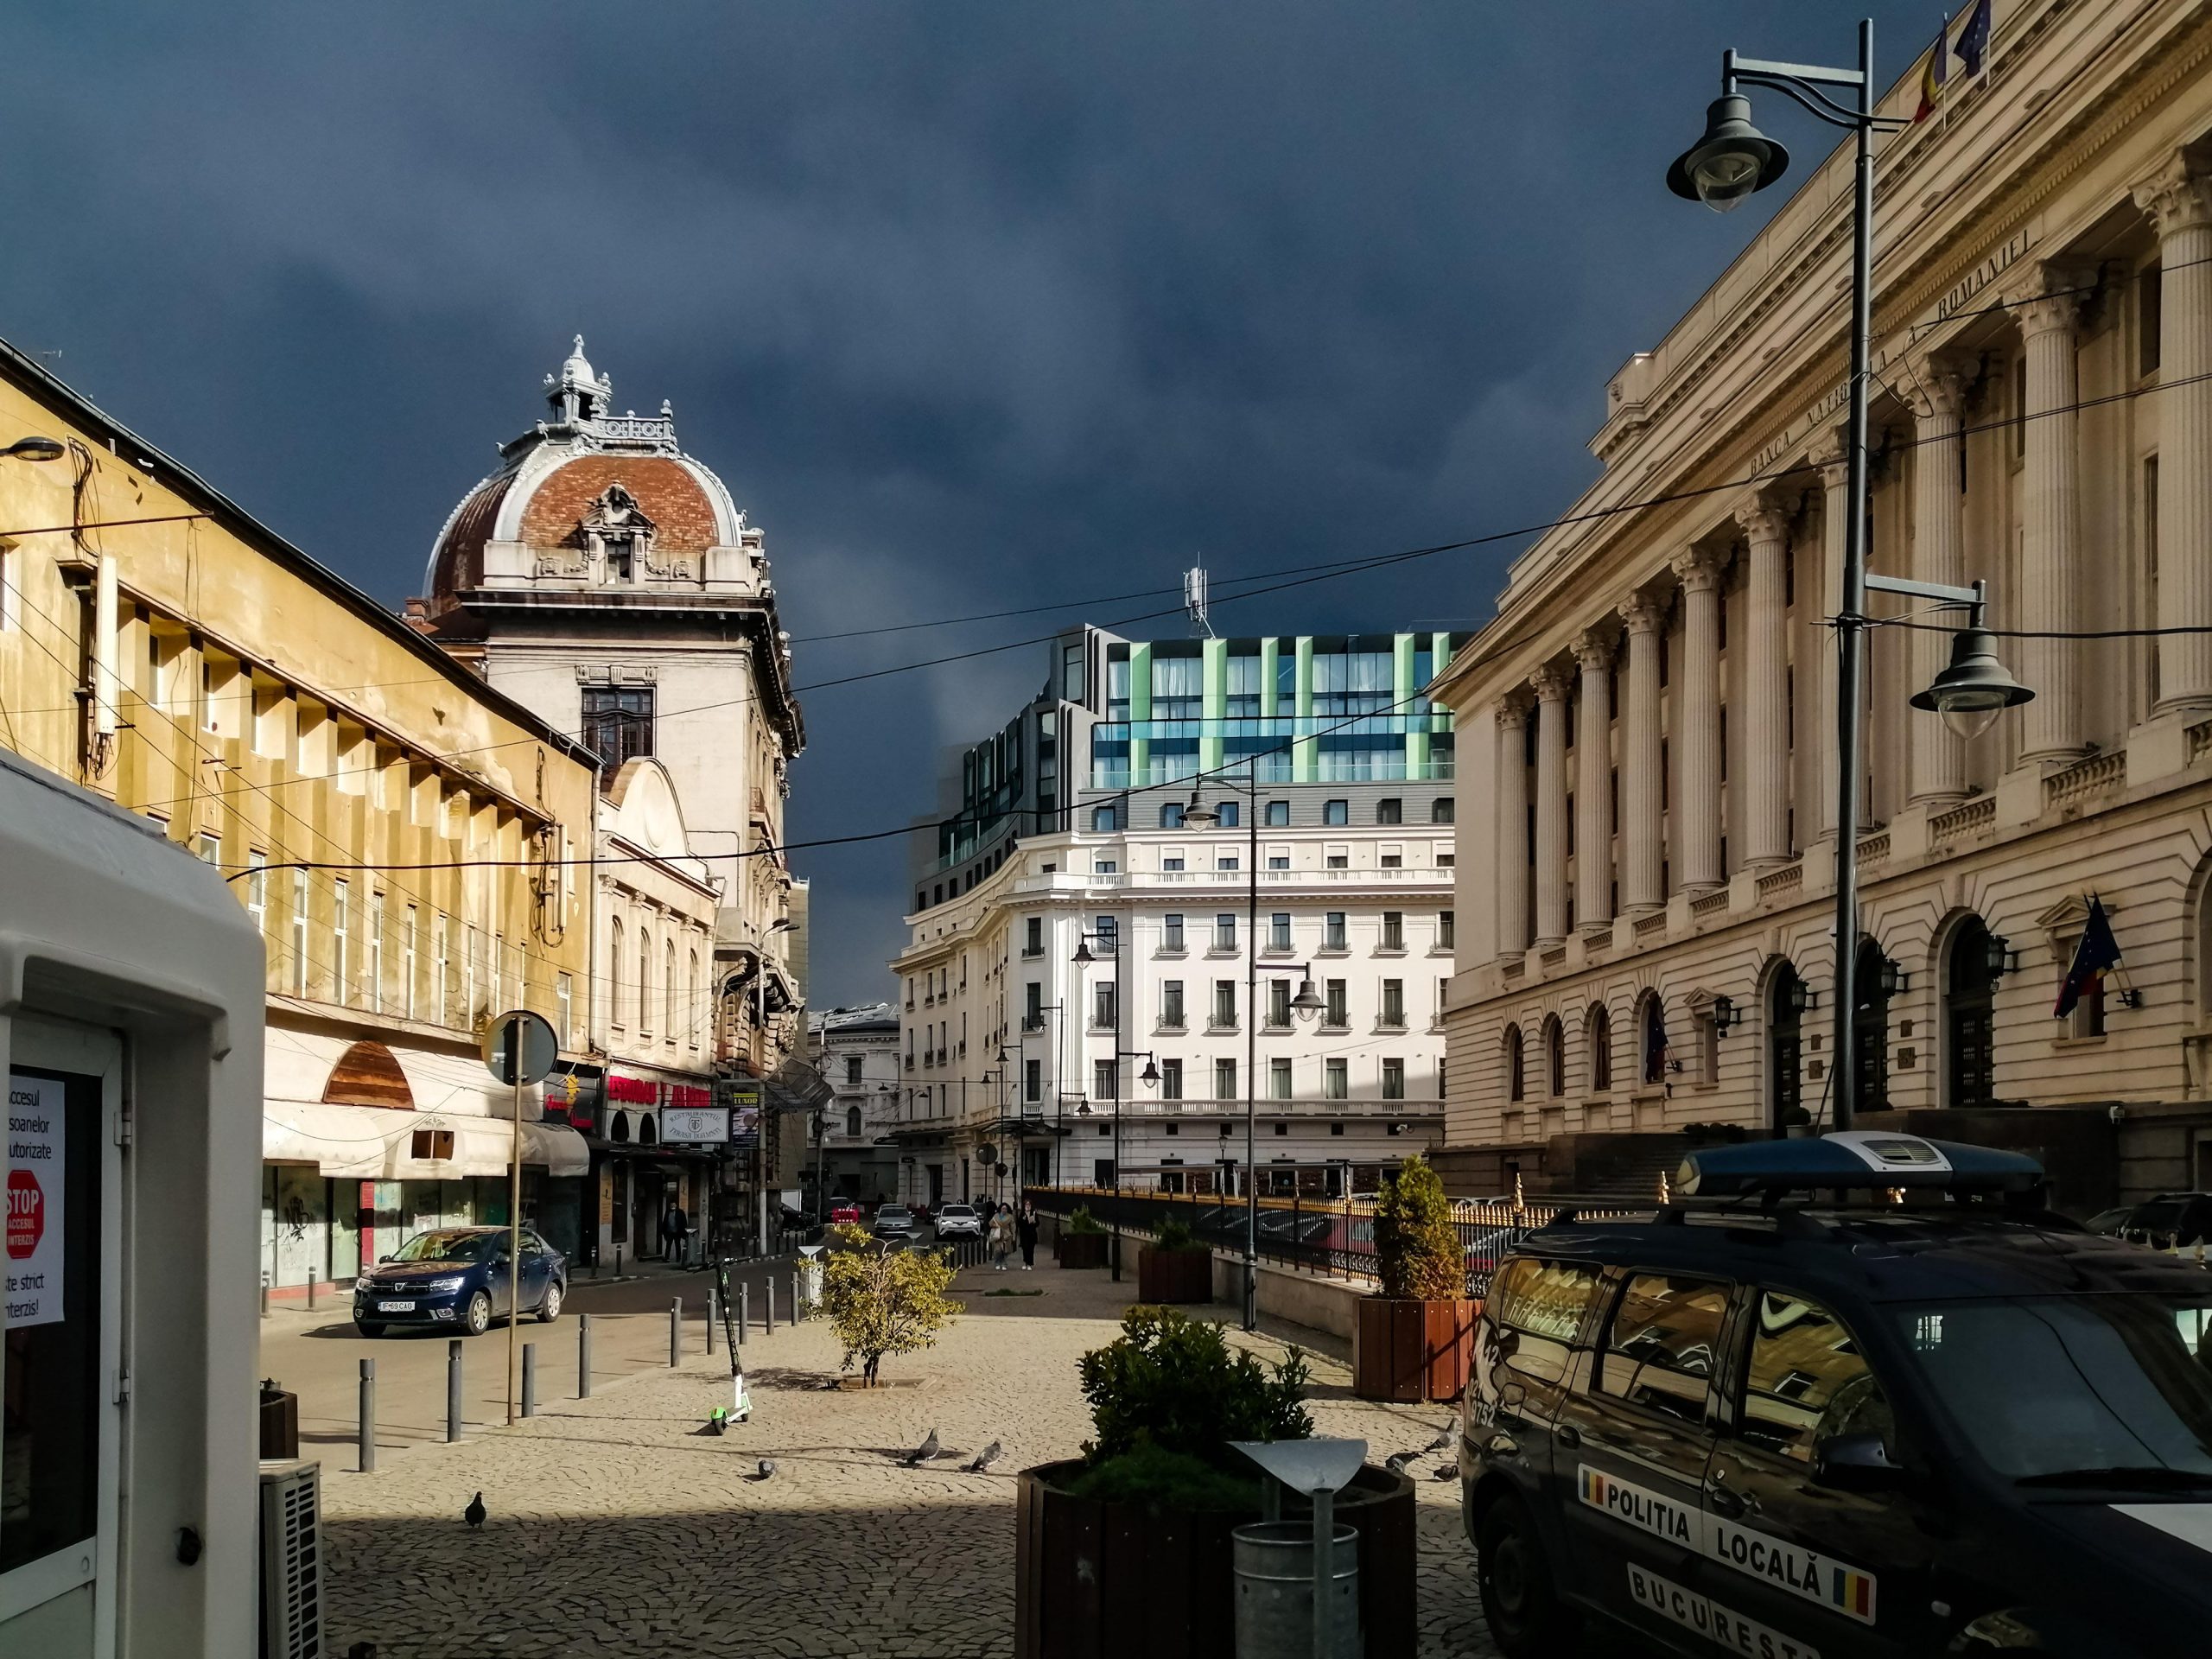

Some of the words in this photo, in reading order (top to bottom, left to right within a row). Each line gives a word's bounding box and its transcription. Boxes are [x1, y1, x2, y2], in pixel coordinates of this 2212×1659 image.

[1750, 430, 1789, 478] BANCA
[9, 1089, 40, 1107] ccesul
[7, 1188, 40, 1215] STOP
[8, 1218, 35, 1230] ACCESUL
[8, 1235, 35, 1246] INTERZIS
[21, 1272, 45, 1290] strict
[1471, 1400, 1496, 1428] 9752
[1717, 1526, 1821, 1597] LOCALĂ
